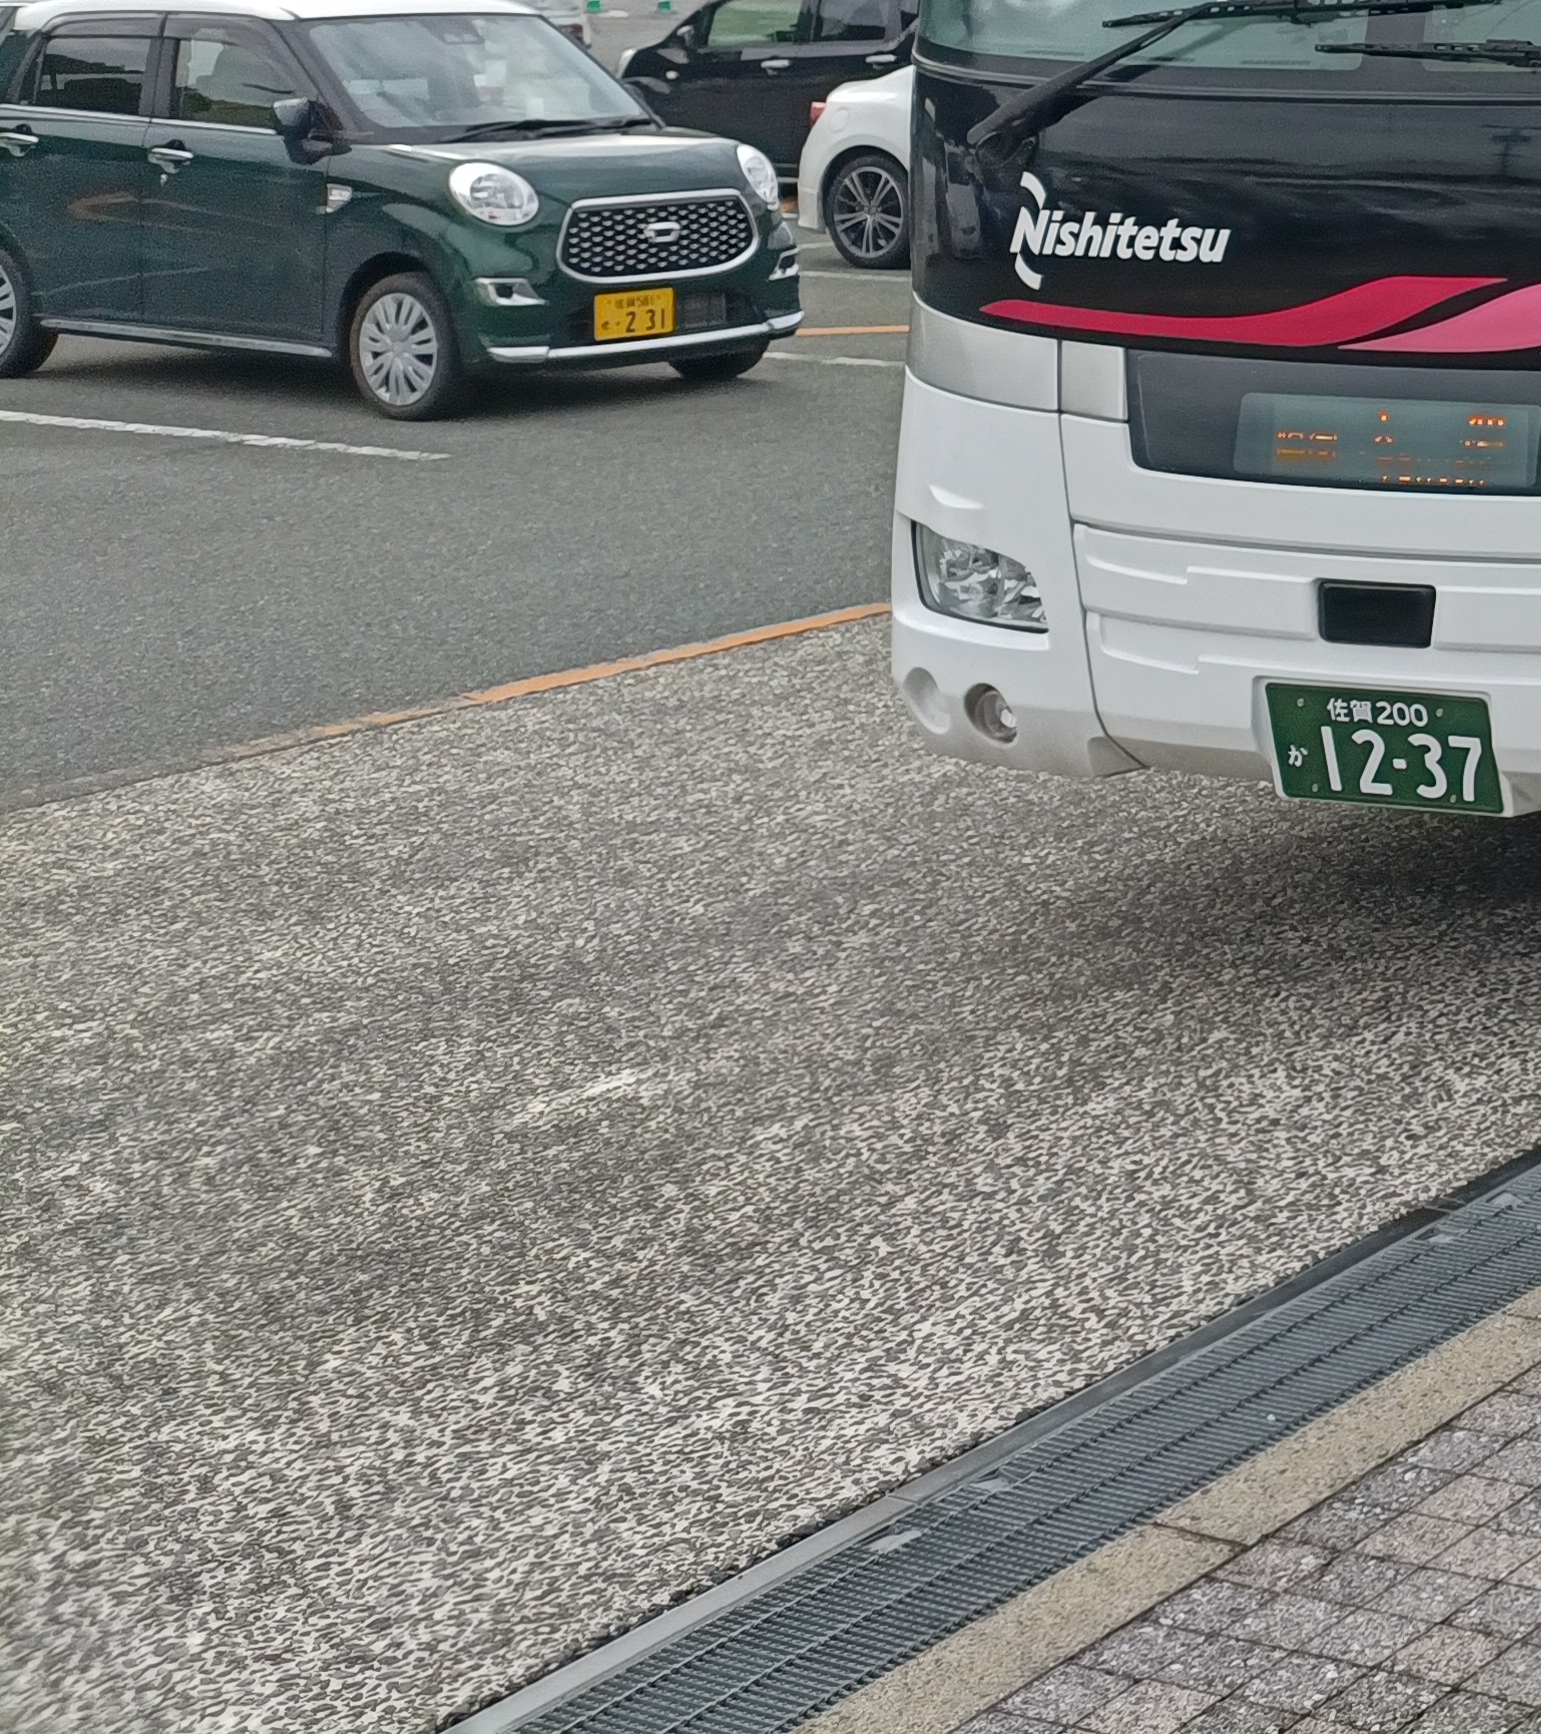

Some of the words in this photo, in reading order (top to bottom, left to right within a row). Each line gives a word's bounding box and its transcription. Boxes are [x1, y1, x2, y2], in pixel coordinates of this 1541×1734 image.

[1010, 192, 1231, 272] Nishitetsu
[1287, 742, 1309, 769] か
[1319, 726, 1484, 803] 12-37
